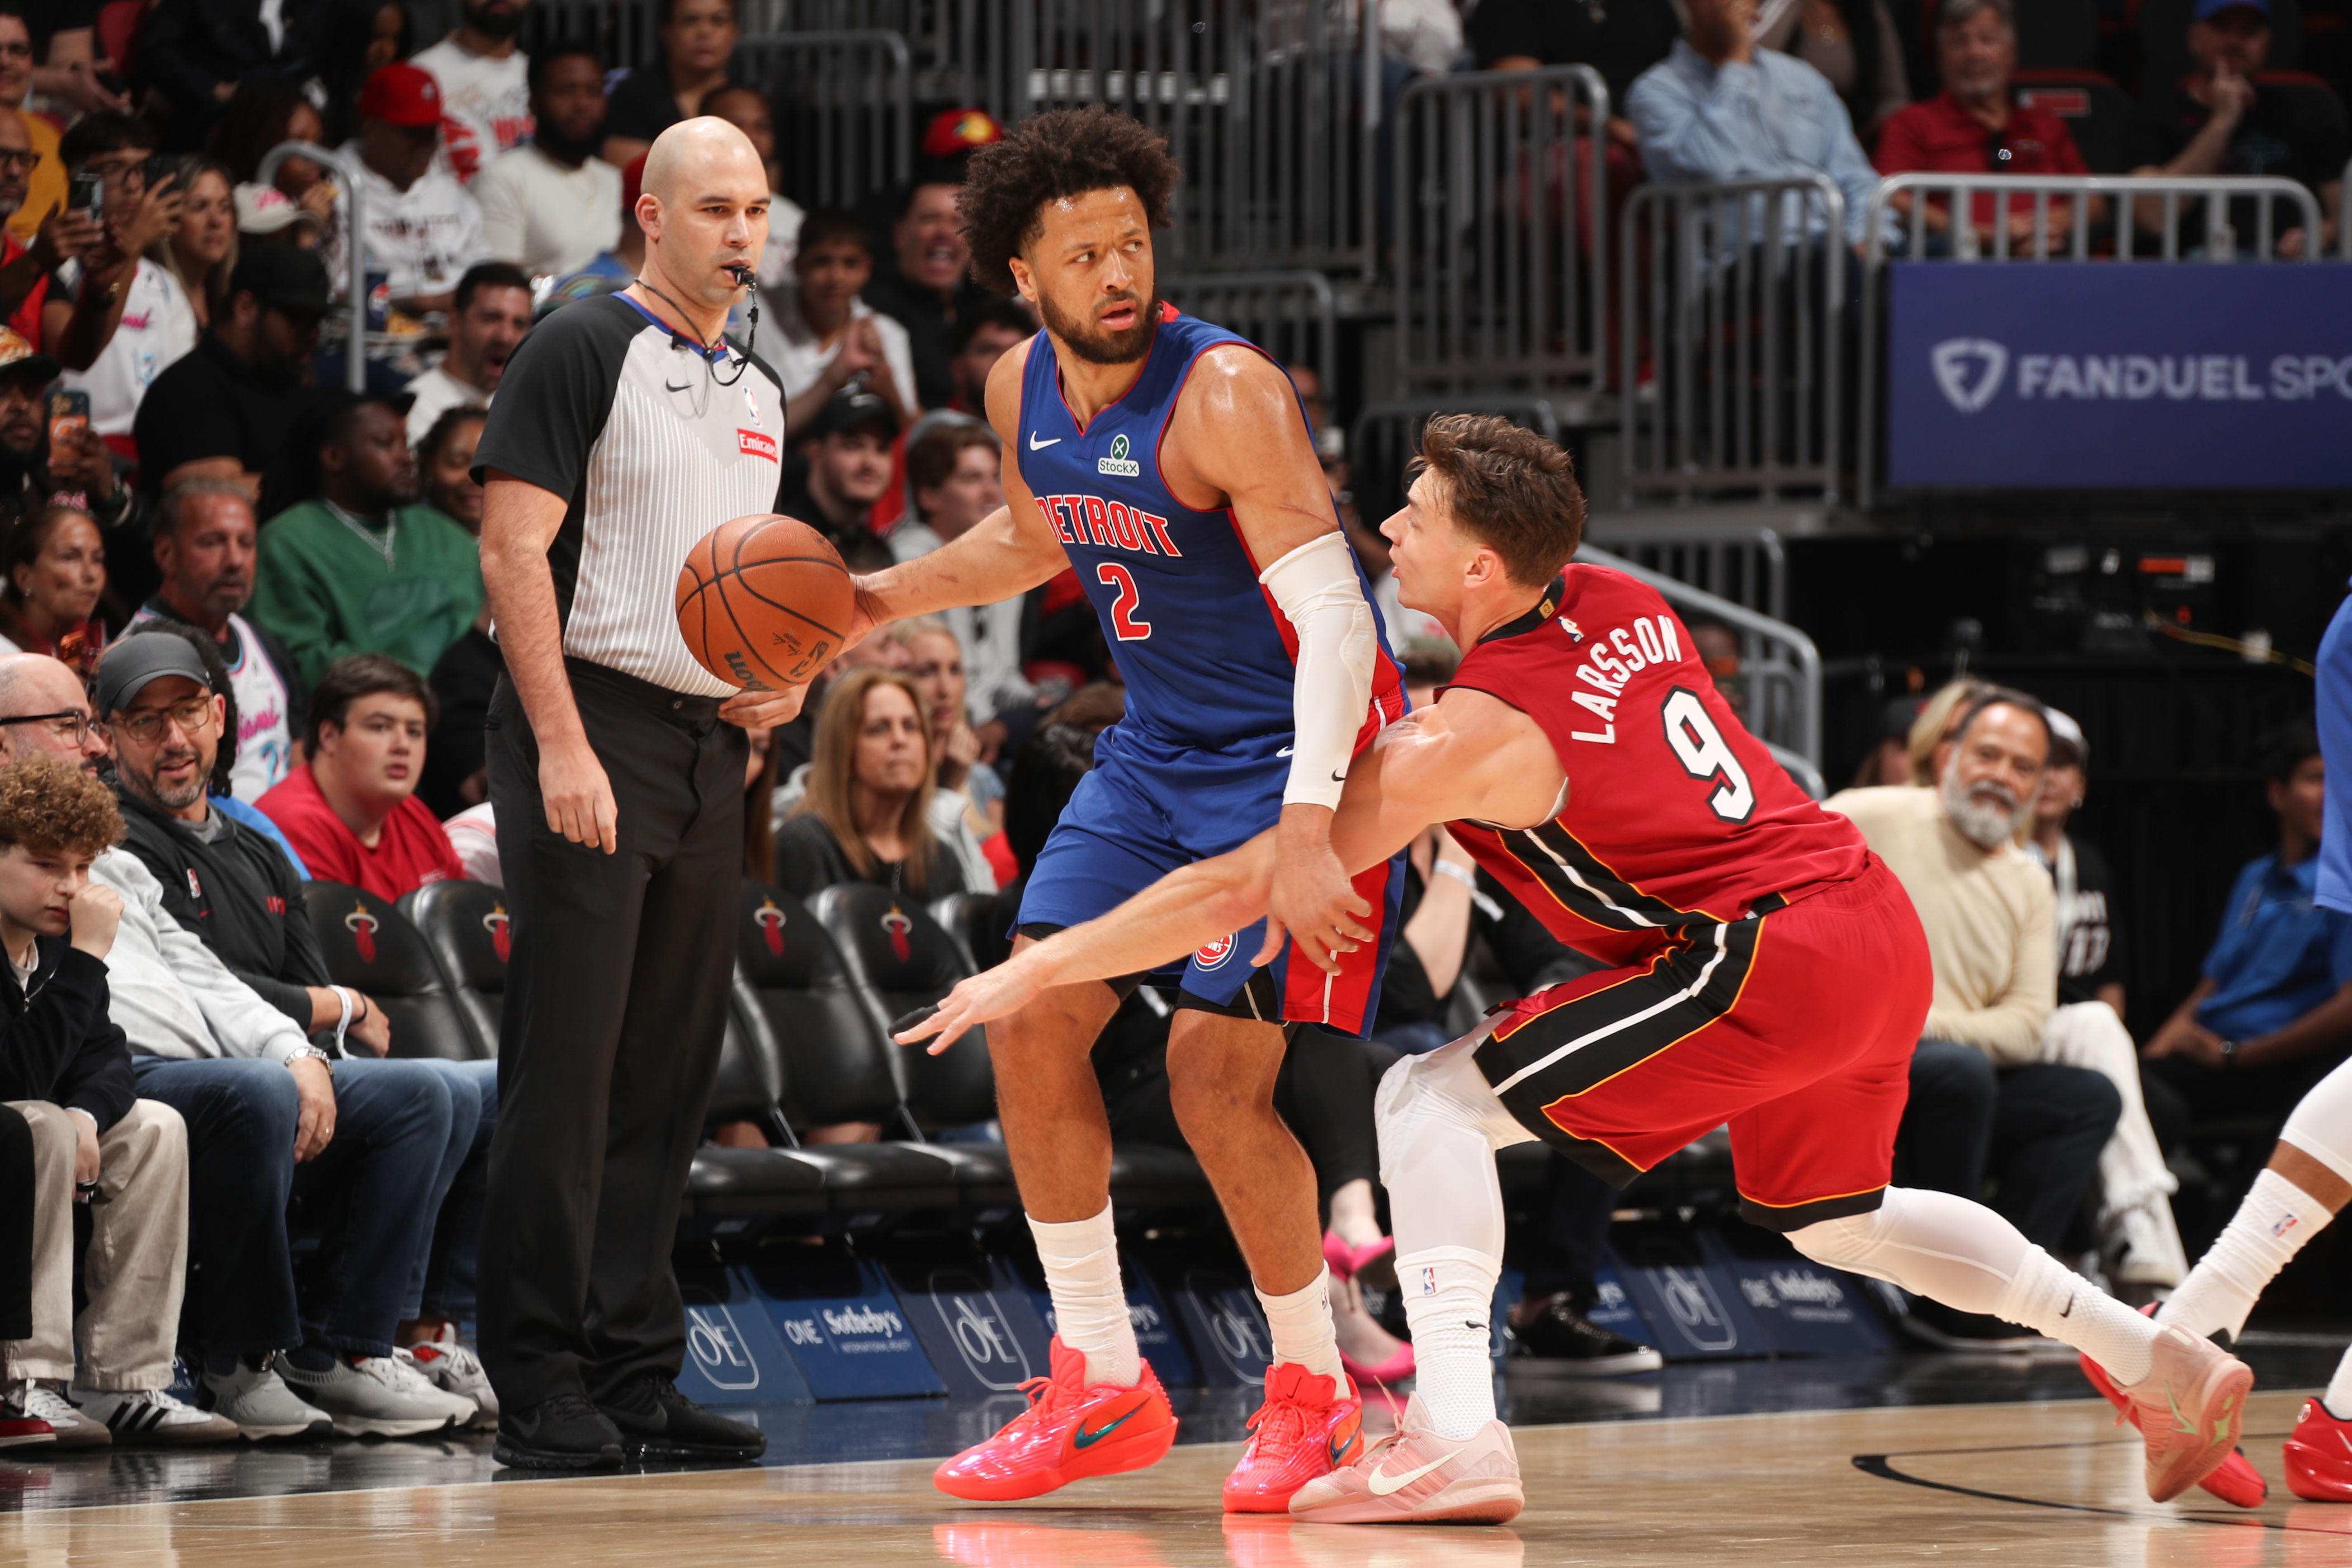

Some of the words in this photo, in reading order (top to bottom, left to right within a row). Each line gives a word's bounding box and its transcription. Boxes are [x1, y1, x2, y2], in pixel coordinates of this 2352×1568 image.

[2019, 355, 2265, 400] FANDUEL
[738, 433, 778, 459] Emirates
[1099, 460, 1137, 475] StockX
[1097, 562, 1152, 641] 2
[1571, 615, 1682, 744] LARSSON
[1660, 684, 1758, 826] 9
[784, 1319, 824, 1345] ONE
[823, 1303, 903, 1339] Sotheby's
